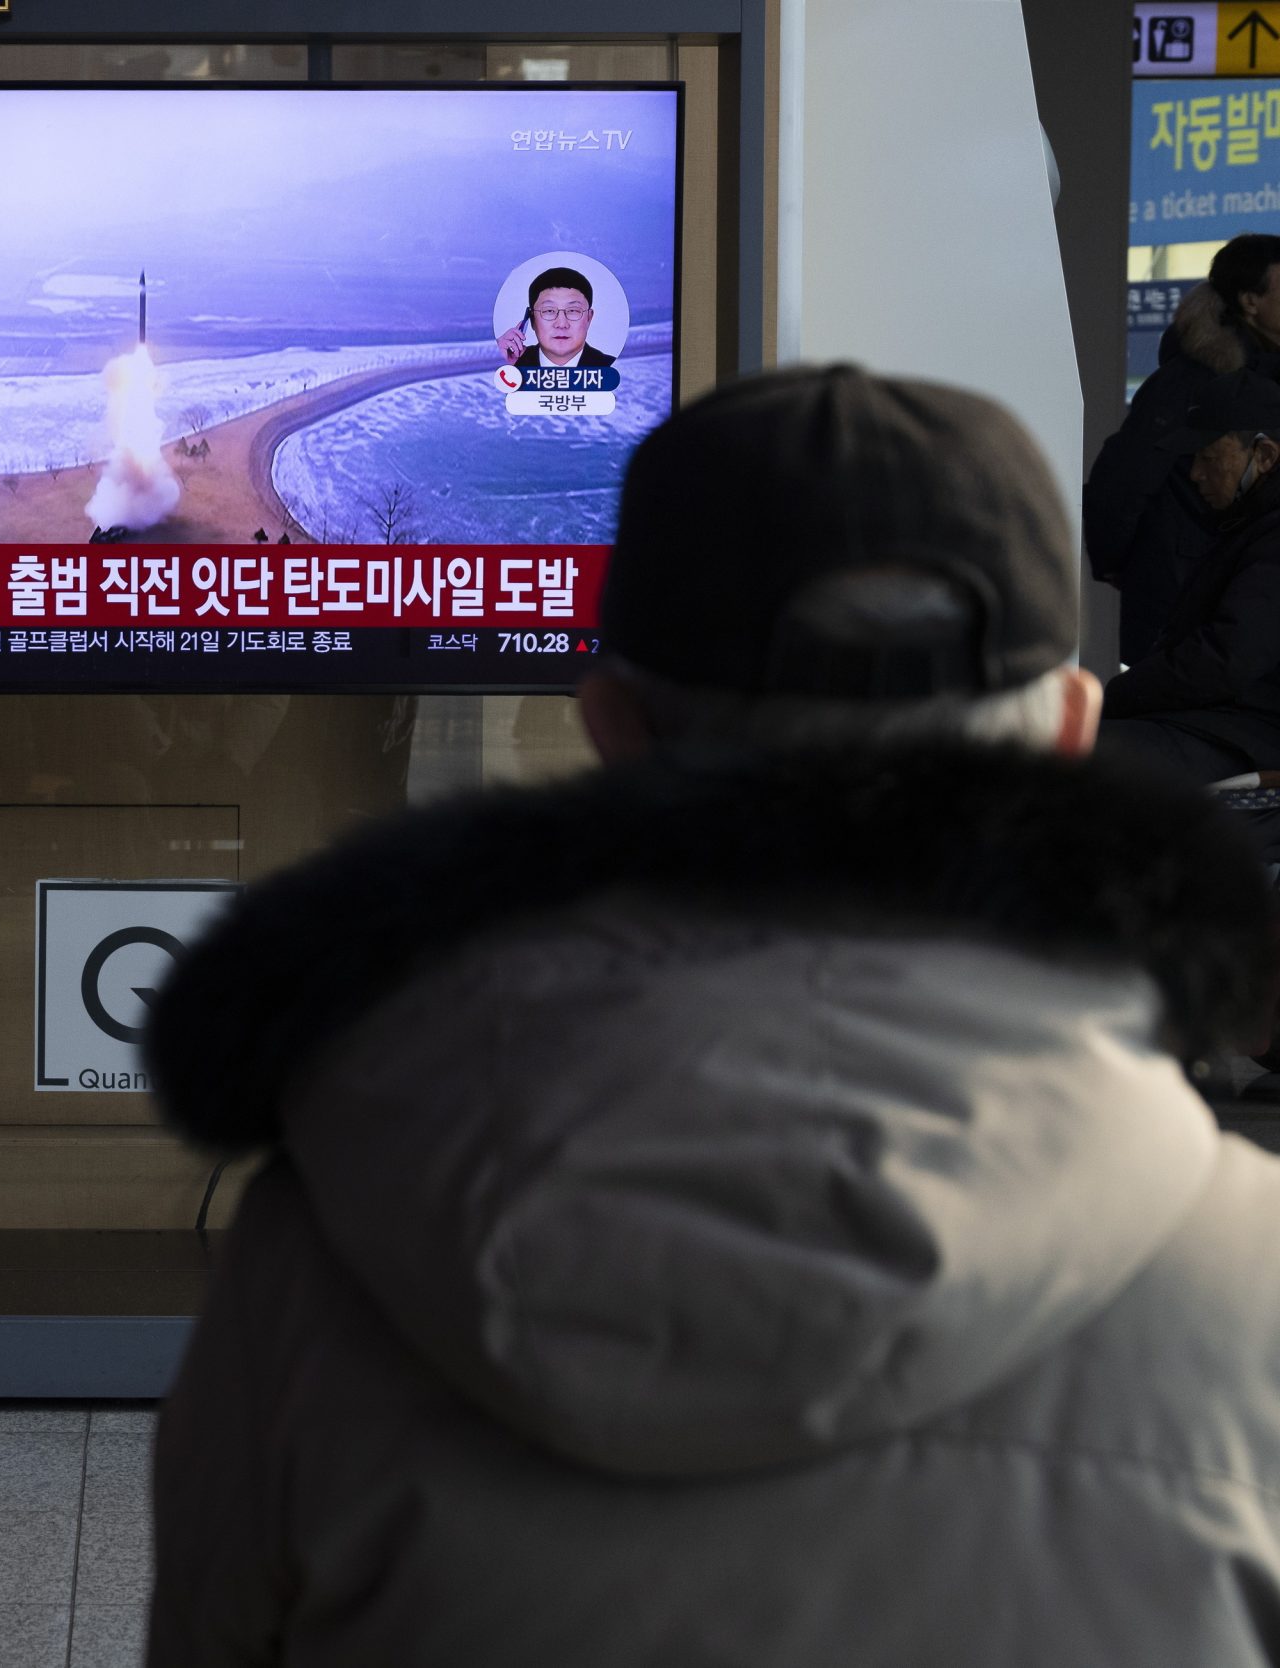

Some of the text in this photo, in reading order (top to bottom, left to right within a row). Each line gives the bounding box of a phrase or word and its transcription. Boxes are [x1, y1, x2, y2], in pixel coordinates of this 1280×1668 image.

[510, 129, 633, 151] 연합뉴스TV
[1161, 189, 1217, 219] ticket
[526, 369, 603, 389] 지성림 기자
[538, 395, 587, 412] 국방부
[7, 556, 88, 616] 출범
[99, 556, 181, 617] 직전
[191, 556, 274, 617] 잇단
[283, 556, 485, 617] 탄도미사일
[494, 557, 579, 617] 도발
[7, 630, 108, 653] 골프클럽서
[114, 630, 175, 653] 시작해
[180, 630, 220, 653] 21일
[227, 630, 307, 653] 기도회로
[311, 631, 353, 653] 종료
[427, 633, 479, 652] 코스닥
[497, 632, 570, 653] 710.28
[79, 1068, 148, 1090] Quan
